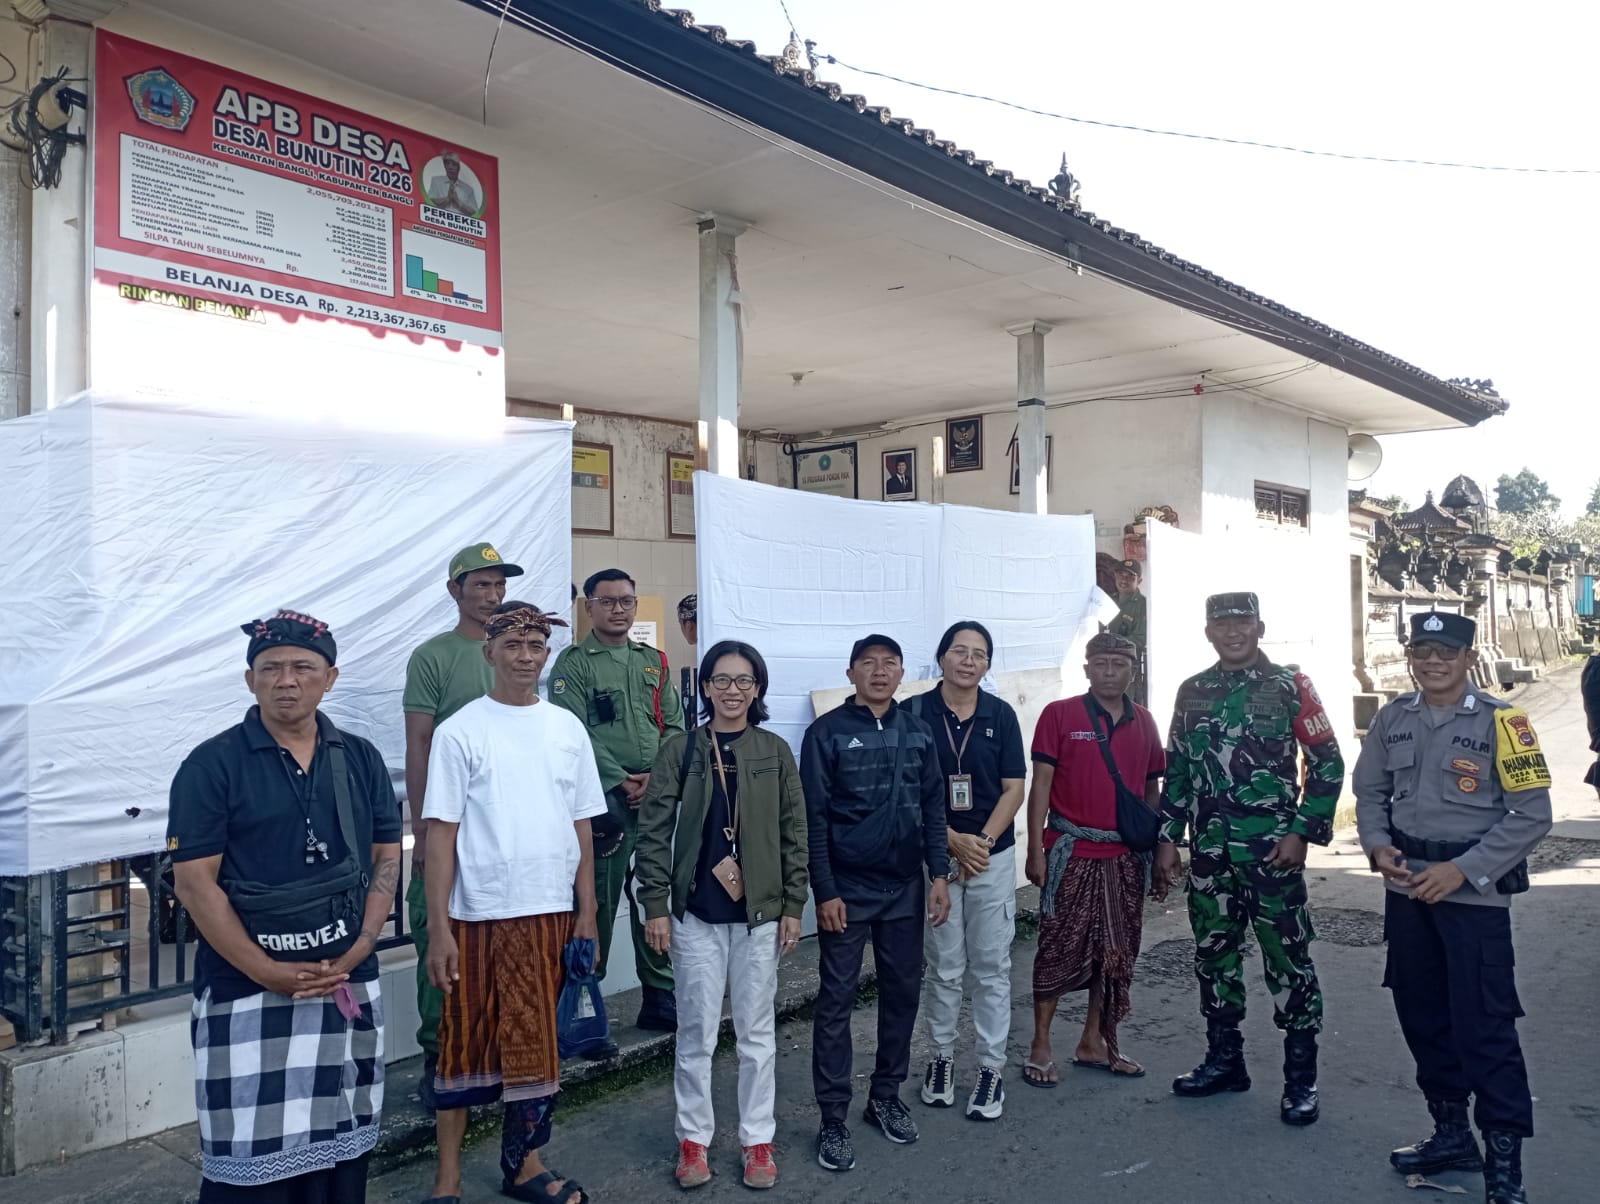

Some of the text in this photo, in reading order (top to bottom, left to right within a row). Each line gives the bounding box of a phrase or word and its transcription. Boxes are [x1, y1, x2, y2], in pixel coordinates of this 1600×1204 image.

[215, 87, 411, 171] APB DESA
[132, 139, 160, 152] TOTAL
[162, 148, 219, 168] PENDAPATAN
[214, 117, 412, 193] DESA BUNUTIN 2026
[213, 142, 413, 206] KECAMATAN BANGLI, KABUPANTEN BANGLI
[423, 206, 484, 229] PERBEKEL
[425, 216, 482, 236] DESA BUNUTIN
[144, 232, 169, 243] SILPA
[172, 237, 204, 250] TAHUN
[206, 245, 265, 264] SEBELUMNYA
[119, 282, 266, 324] RINCIAN BELANJA
[166, 267, 447, 335] BELANJA DESA Rp. 2,213,367,367.65
[1388, 732, 1413, 744] ADMA
[1452, 736, 1490, 754] POLRI
[1510, 770, 1530, 779] DESA
[1515, 776, 1534, 784] KEC.
[257, 919, 349, 951] FOREVER
